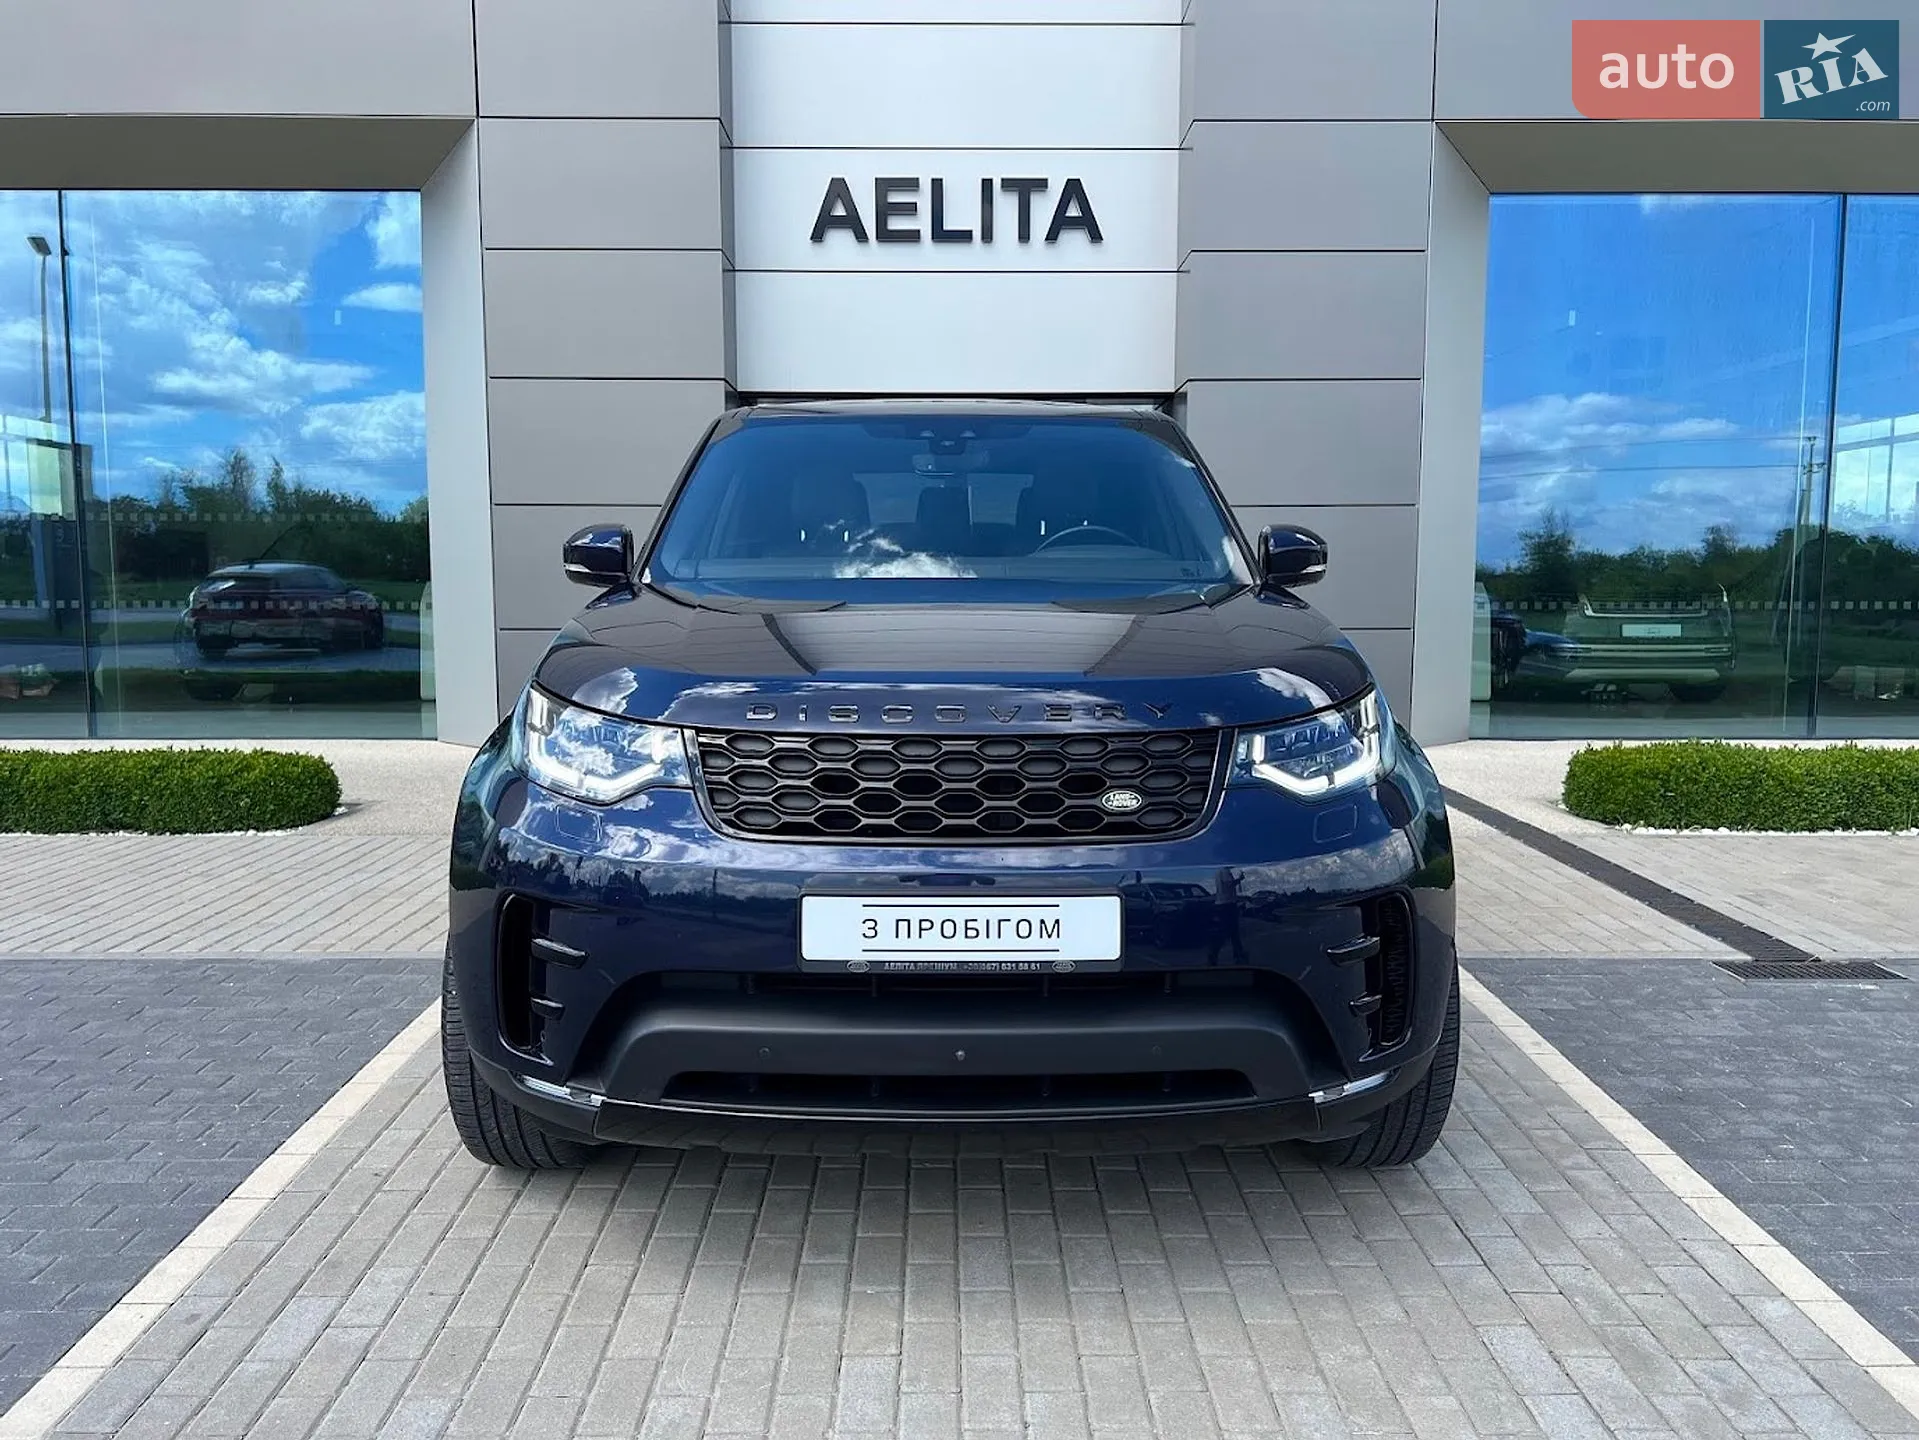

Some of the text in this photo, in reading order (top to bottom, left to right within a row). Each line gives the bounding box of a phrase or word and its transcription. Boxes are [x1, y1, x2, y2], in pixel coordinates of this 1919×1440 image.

[810, 177, 1104, 243] AELITA
[746, 702, 1175, 723] DISCOVERY
[894, 918, 1061, 939] ПРОБІГОМ
